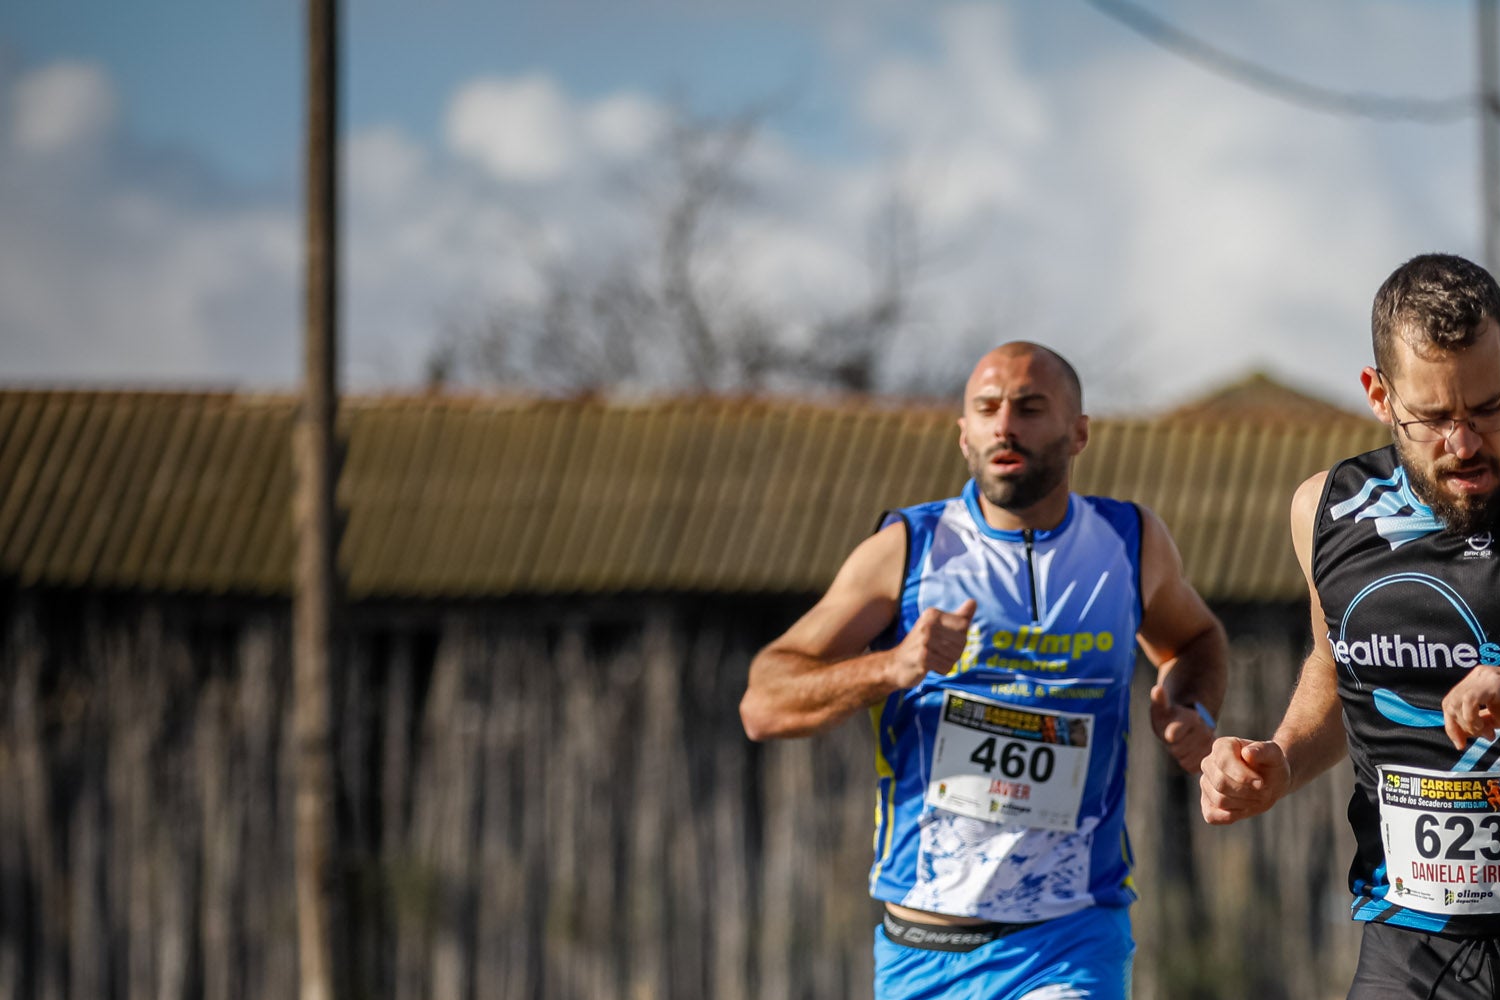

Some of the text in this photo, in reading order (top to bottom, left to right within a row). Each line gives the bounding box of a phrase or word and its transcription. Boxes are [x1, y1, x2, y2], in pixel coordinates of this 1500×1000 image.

[992, 625, 1114, 660] olimpo
[986, 654, 1068, 673] deportes
[991, 684, 1031, 698] TRAIL
[970, 737, 1056, 783] 460
[989, 779, 1031, 800] JAVIER
[1421, 778, 1482, 791] CARRERA
[1399, 795, 1407, 803] de
[1408, 796, 1417, 805] los
[1418, 798, 1452, 809] Secaderos
[1421, 789, 1483, 800] POPULAR
[1411, 861, 1466, 884] DANIELA
[1470, 865, 1479, 884] E
[1457, 889, 1494, 899] olimpo
